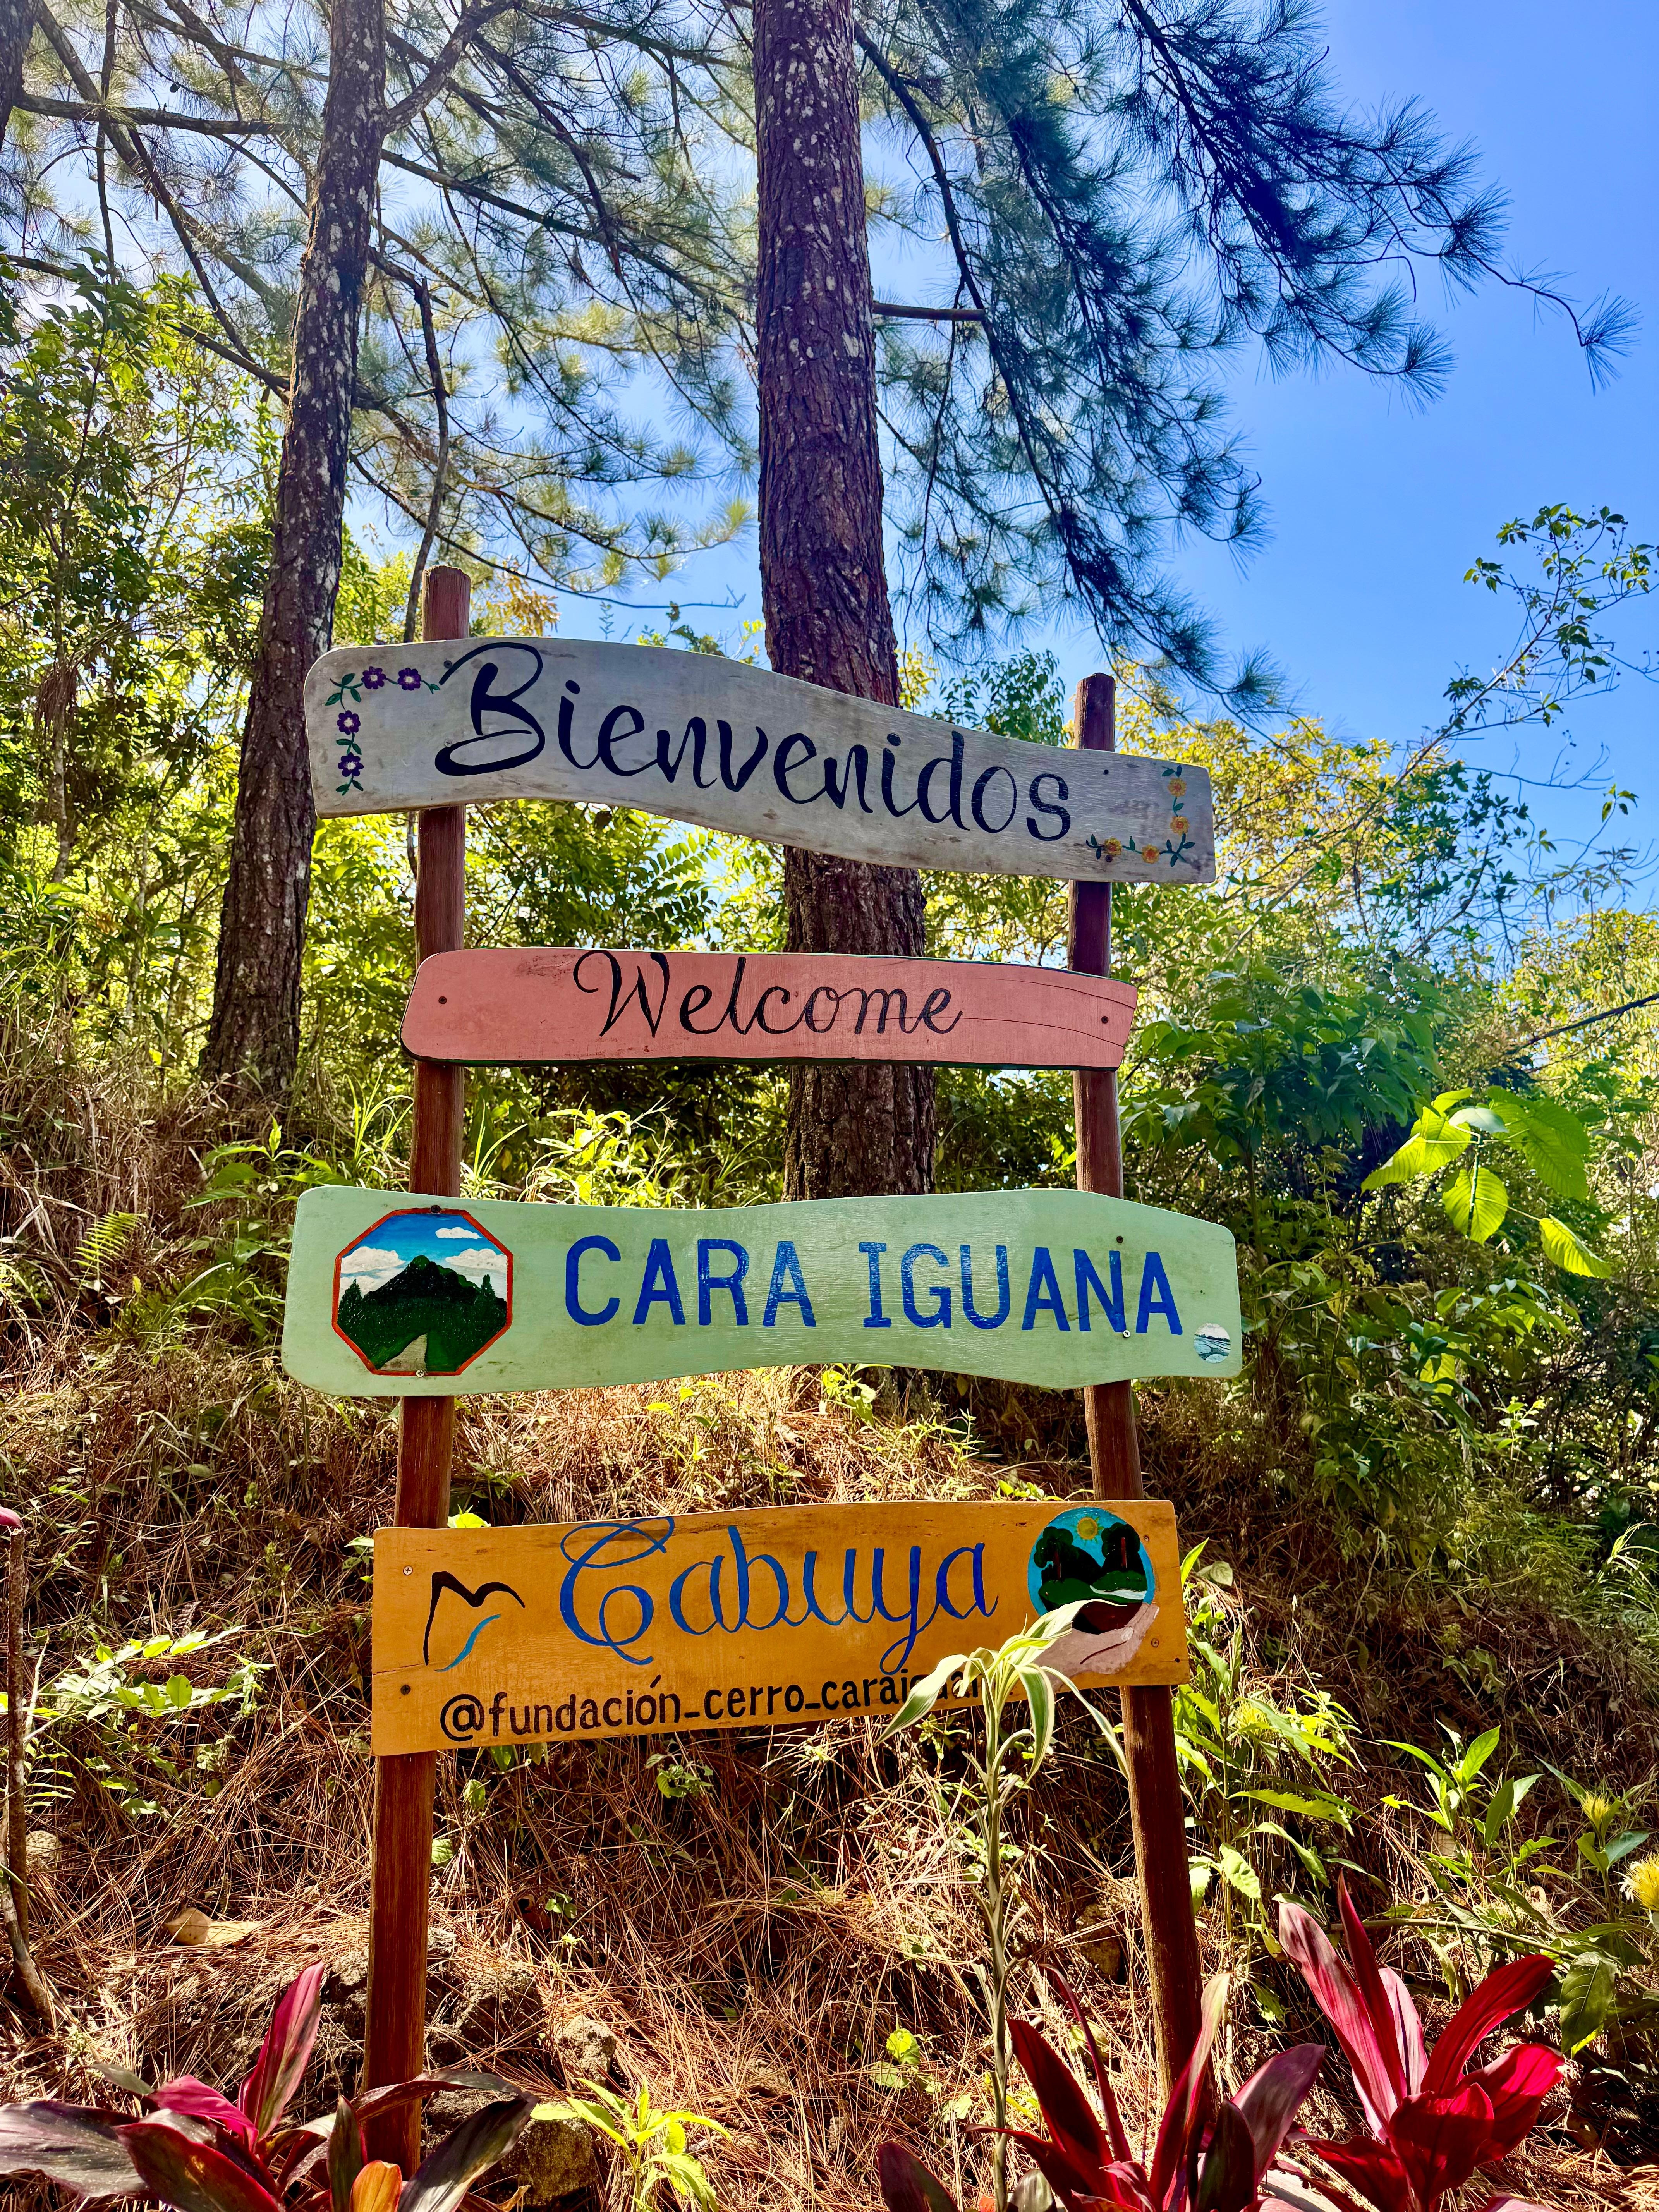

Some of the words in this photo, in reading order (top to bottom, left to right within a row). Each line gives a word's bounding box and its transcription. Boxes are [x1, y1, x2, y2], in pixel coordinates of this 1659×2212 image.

[434, 642, 1070, 841] Bienvenidos
[573, 950, 963, 1038] Welcome
[565, 1235, 816, 1327] CARA
[858, 1242, 1184, 1335] IGUANA
[559, 1518, 998, 1675] Cabuya
